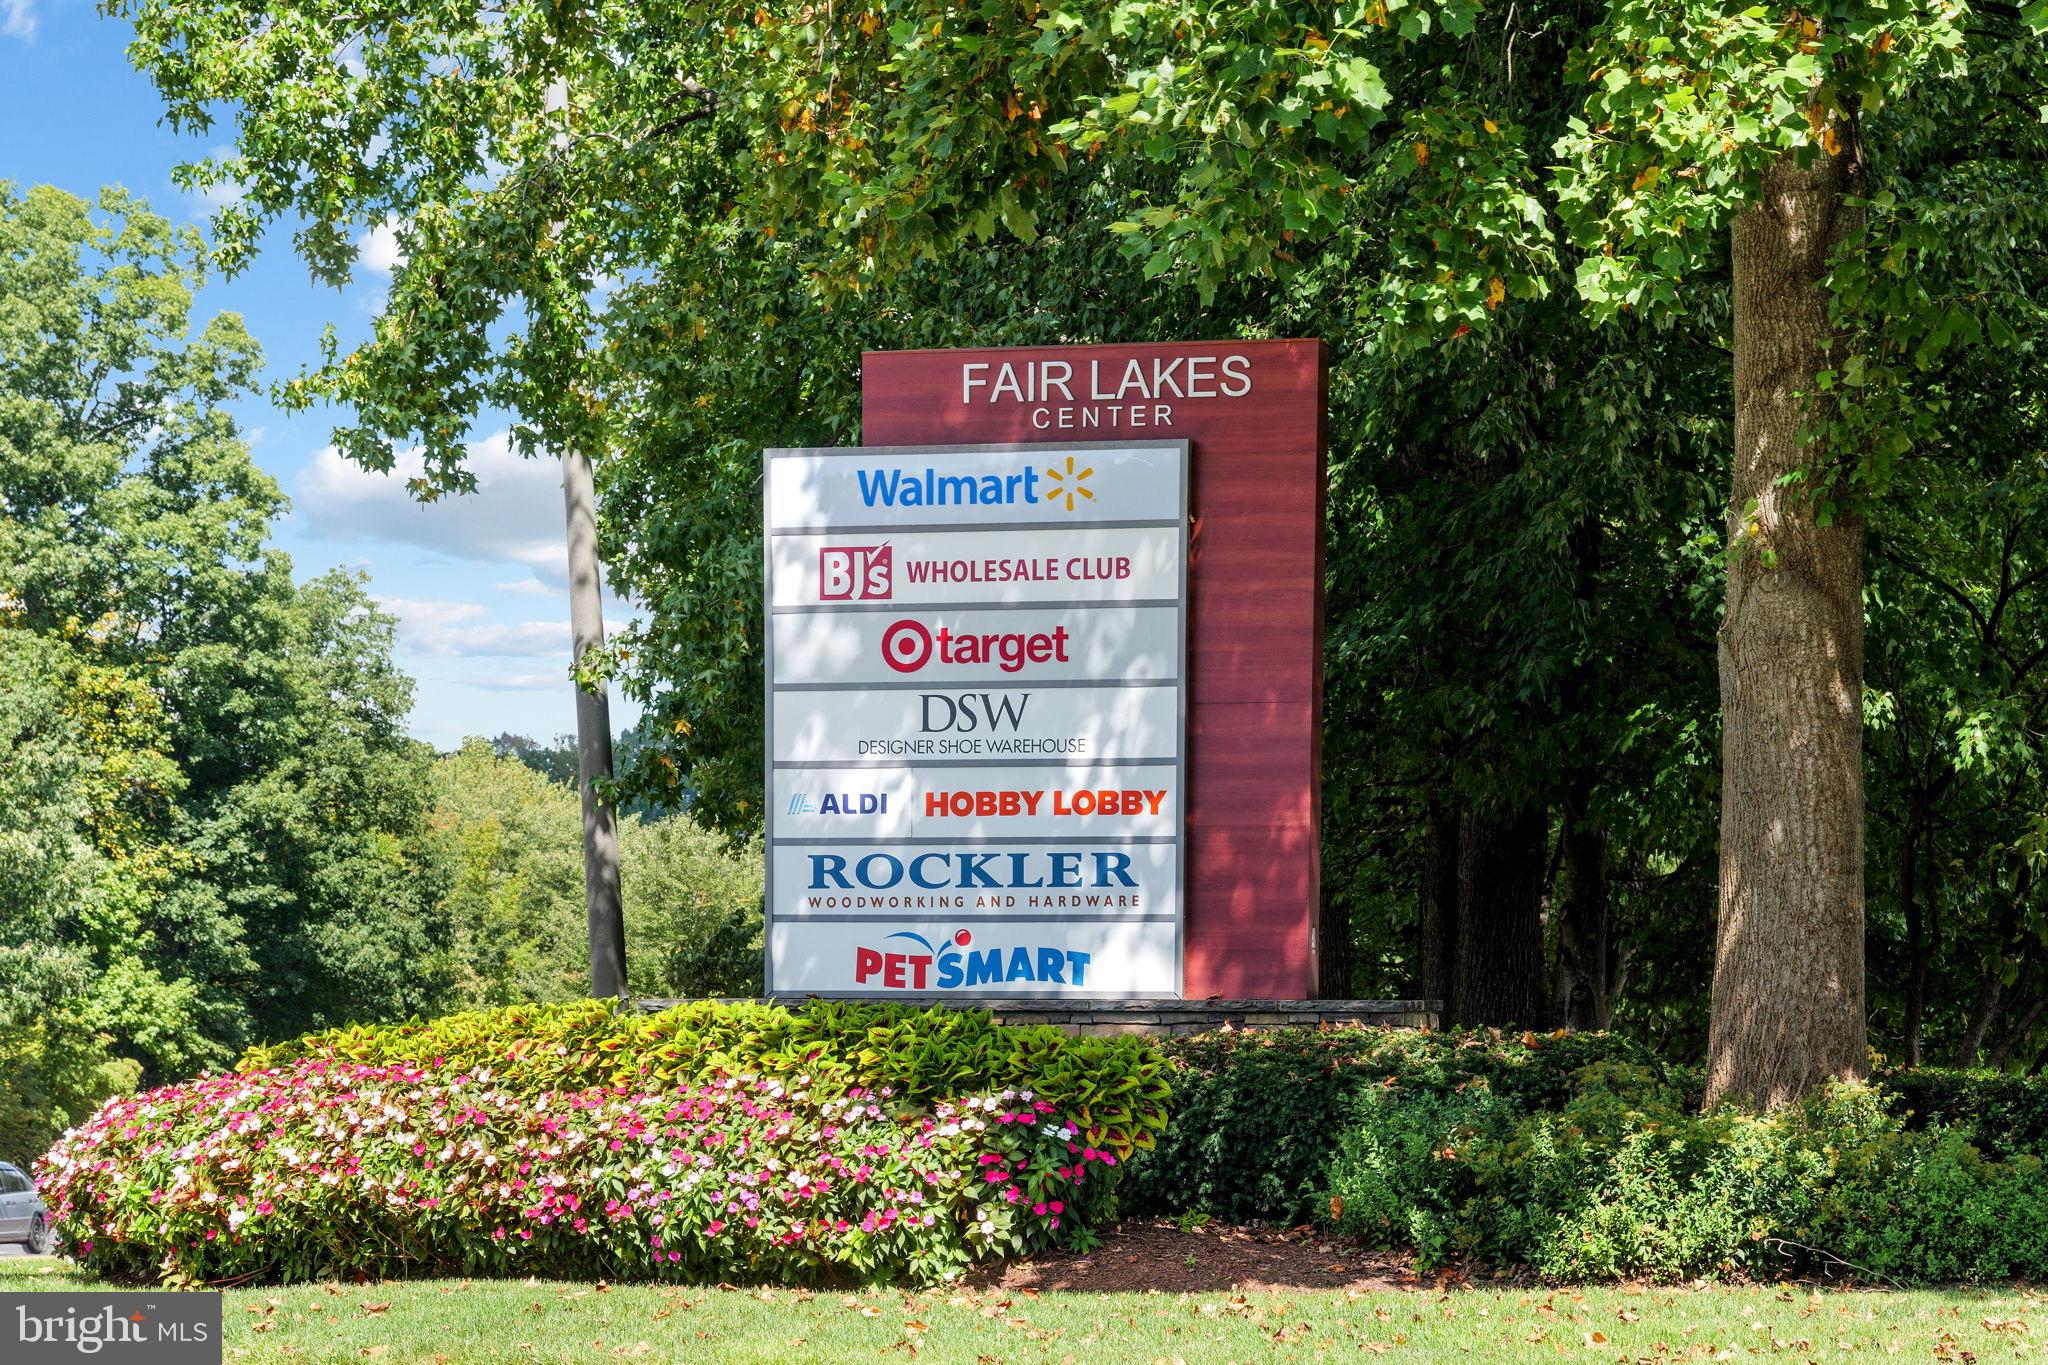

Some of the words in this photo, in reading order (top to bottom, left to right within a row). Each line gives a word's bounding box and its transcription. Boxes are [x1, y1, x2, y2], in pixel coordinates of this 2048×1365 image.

[962, 360, 1074, 404] FAIR
[1091, 355, 1253, 399] LAKES
[1031, 404, 1174, 430] CENTER
[858, 467, 1038, 507] Walmart
[906, 558, 1060, 584] WHOLESALE
[1065, 556, 1131, 581] CLUB
[937, 626, 1068, 672] target
[918, 693, 1032, 733] DSW
[857, 740, 935, 755] DESIGNER
[938, 739, 983, 754] SHOE
[985, 737, 1087, 754] WAREHOUSE
[819, 793, 888, 815] ALDI
[925, 792, 1044, 816] HOBBY
[1053, 790, 1167, 815] LOBBY
[808, 852, 1139, 889] ROCKLER
[808, 896, 965, 908] WOODWORKING
[976, 896, 1016, 908] AND
[1028, 895, 1140, 908] HARDWARE
